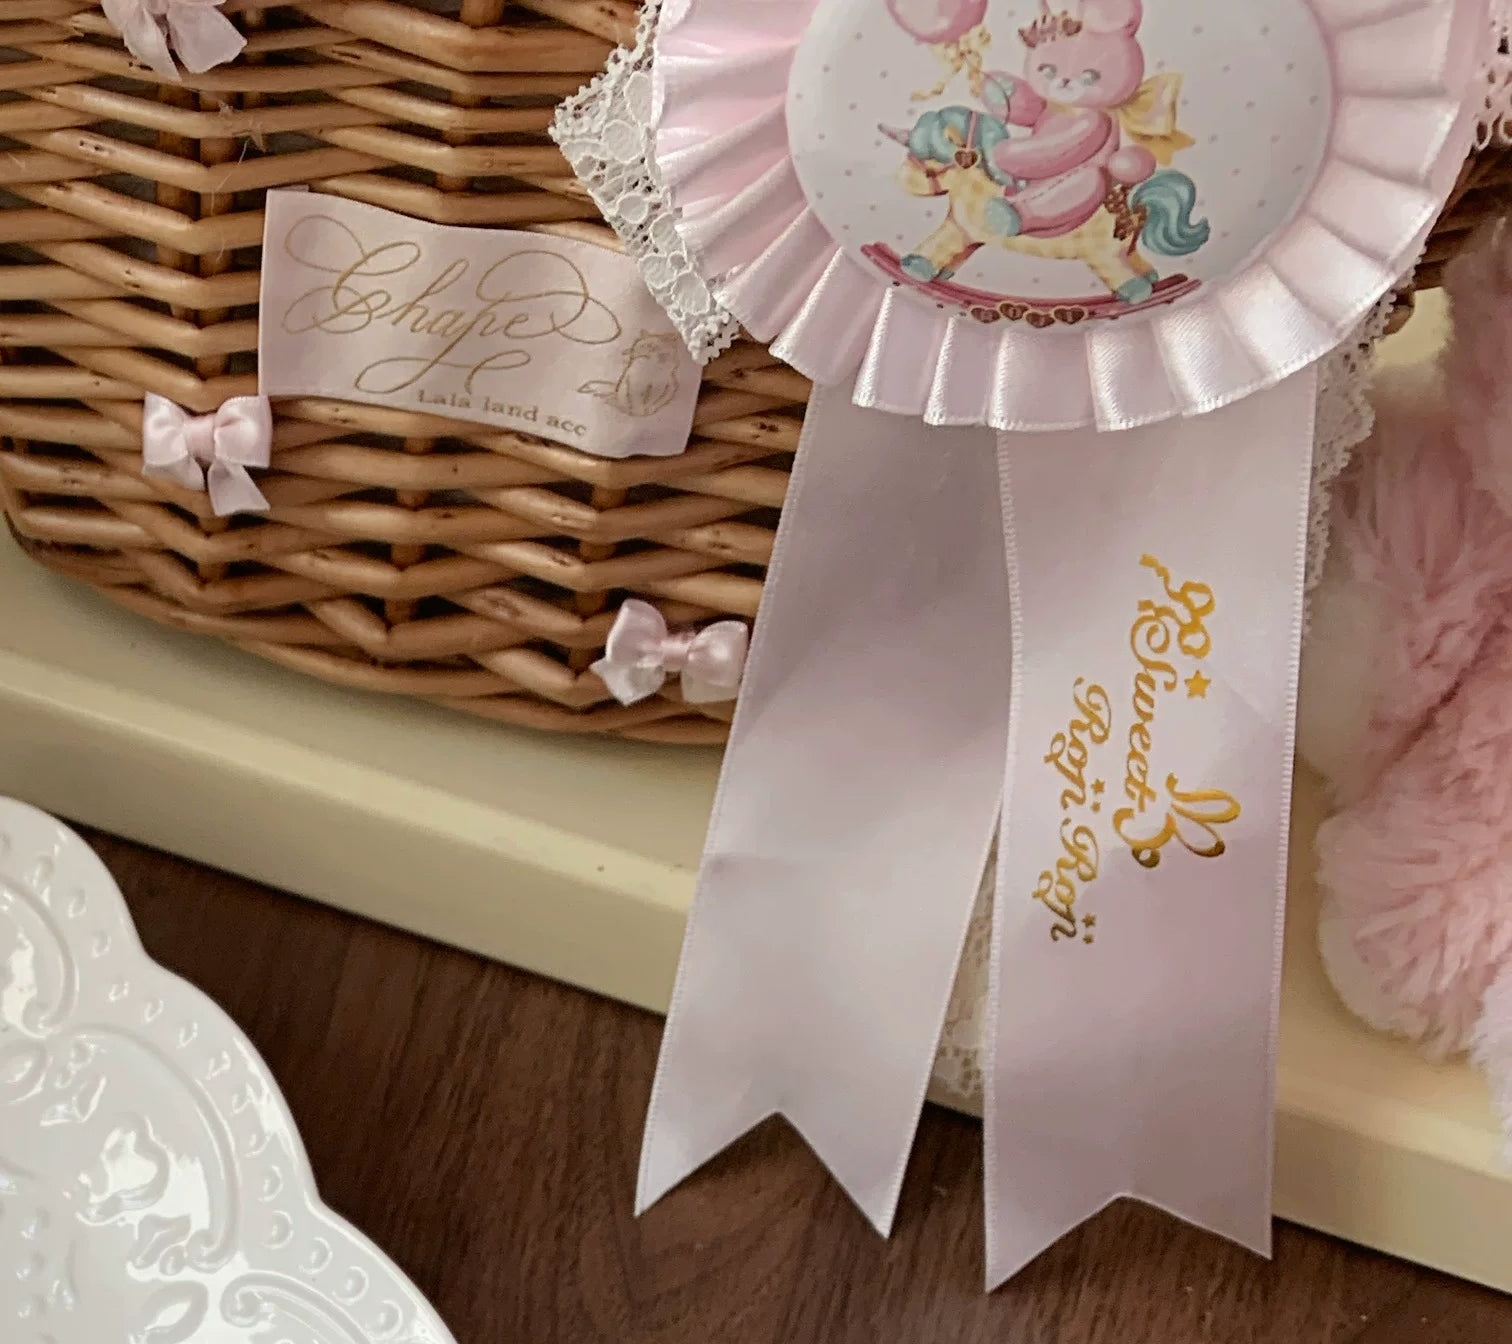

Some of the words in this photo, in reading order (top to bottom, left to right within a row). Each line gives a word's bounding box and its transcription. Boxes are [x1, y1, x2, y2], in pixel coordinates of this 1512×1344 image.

[482, 396, 539, 422] land
[545, 413, 589, 437] acc
[1124, 615, 1178, 812] Sweet
